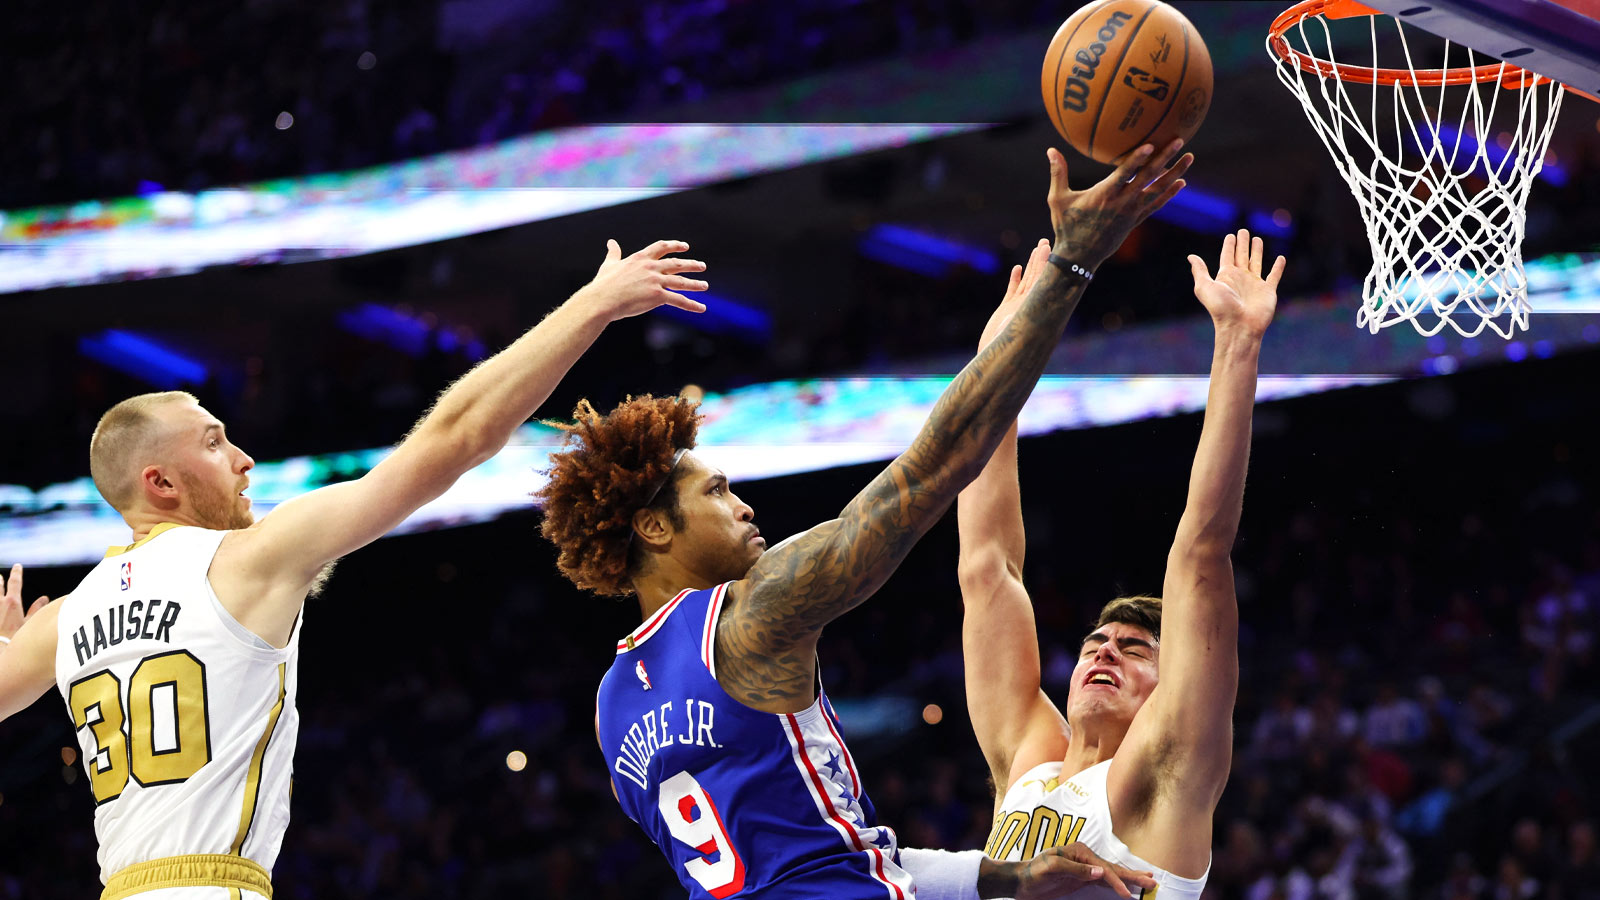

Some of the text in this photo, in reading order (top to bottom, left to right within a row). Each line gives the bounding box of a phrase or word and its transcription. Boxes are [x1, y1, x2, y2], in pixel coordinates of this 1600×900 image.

[1063, 10, 1133, 113] Wilson
[72, 599, 182, 667] HAUSER
[68, 648, 213, 807] 30
[614, 698, 724, 790] OUBRE JR.
[658, 769, 746, 900] 9
